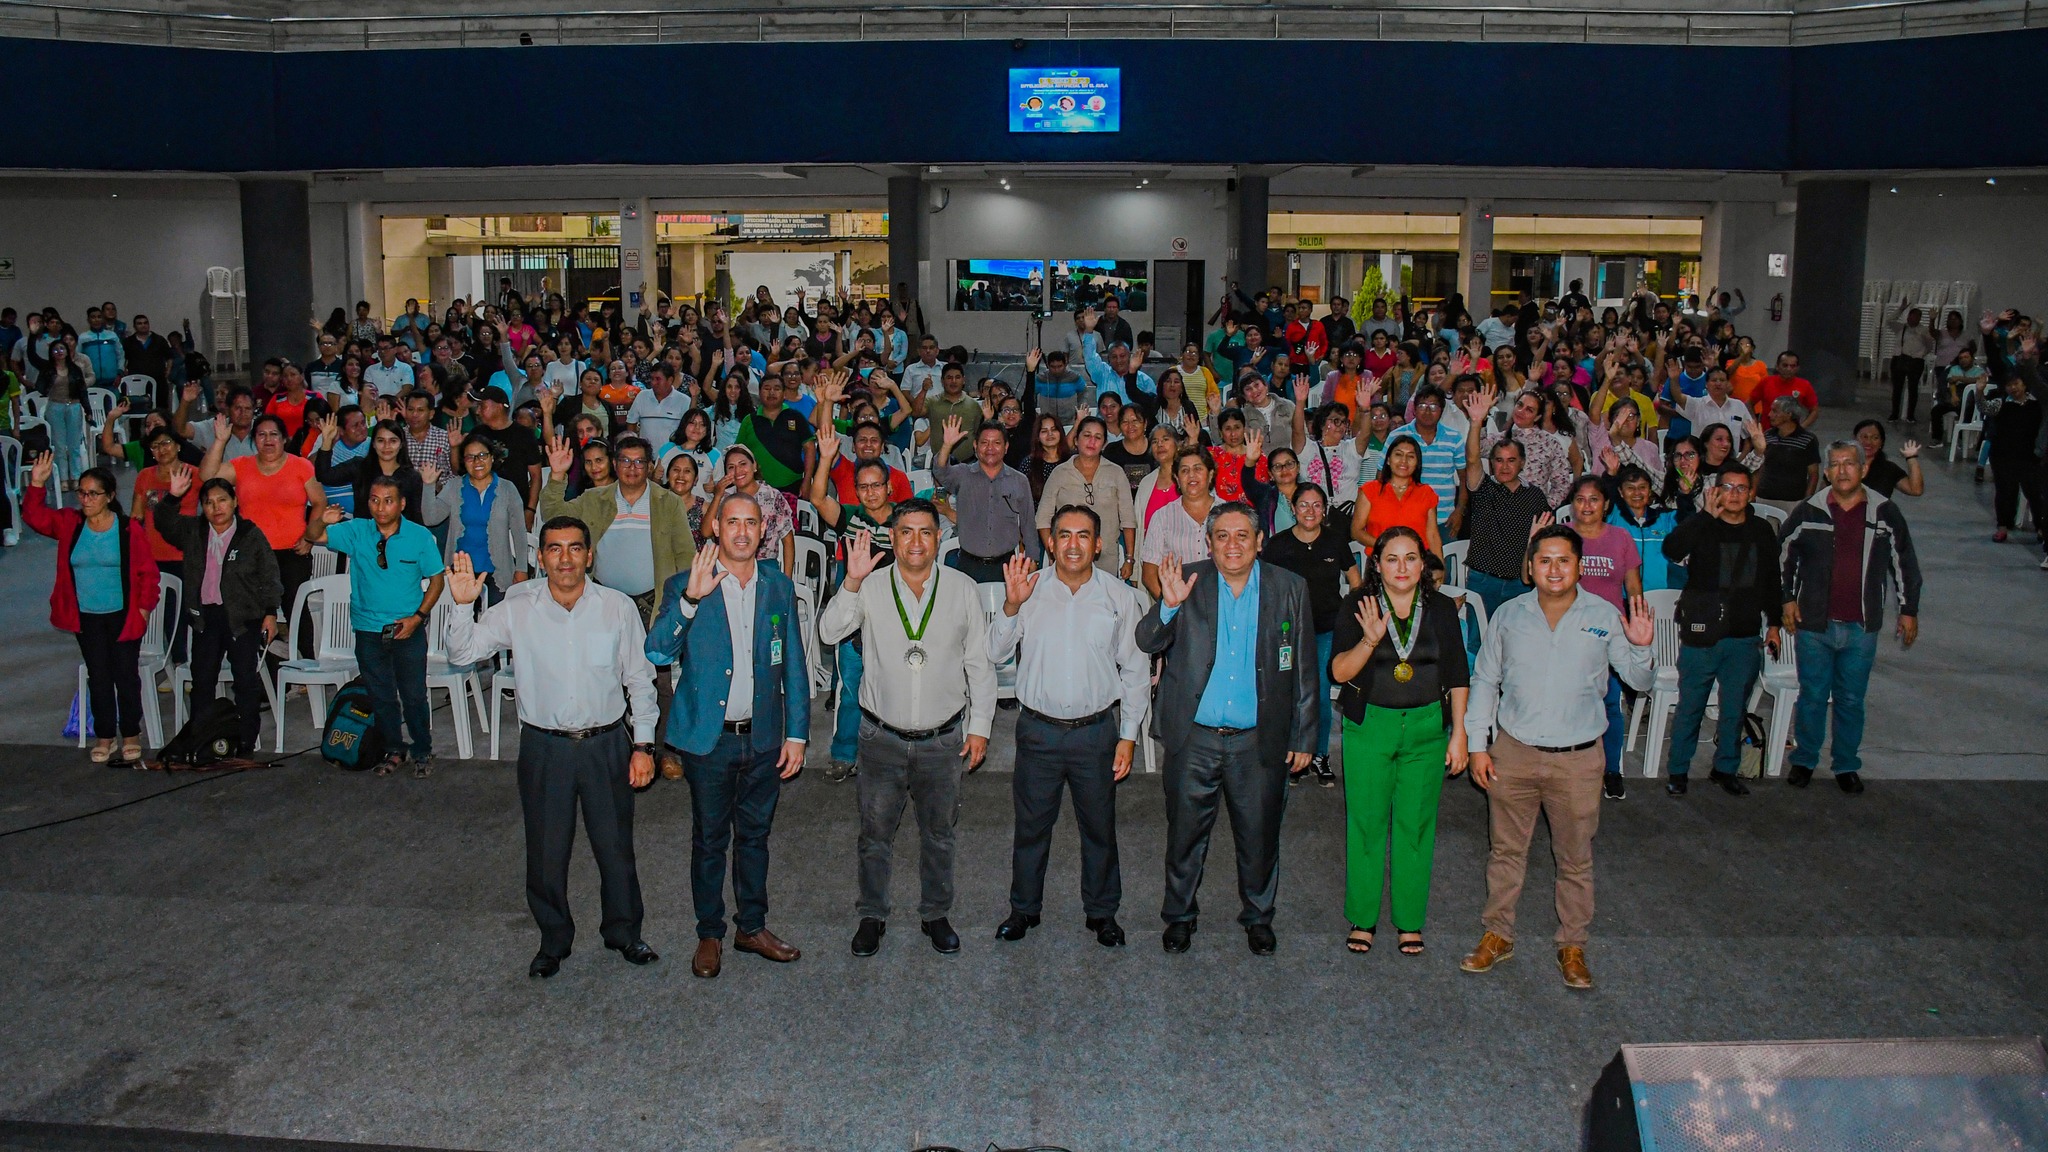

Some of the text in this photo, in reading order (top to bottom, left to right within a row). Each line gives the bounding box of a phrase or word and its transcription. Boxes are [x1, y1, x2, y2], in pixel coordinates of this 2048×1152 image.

[679, 214, 711, 223] MOTORS
[1298, 237, 1323, 246] SALIDA
[329, 729, 359, 751] CAT
